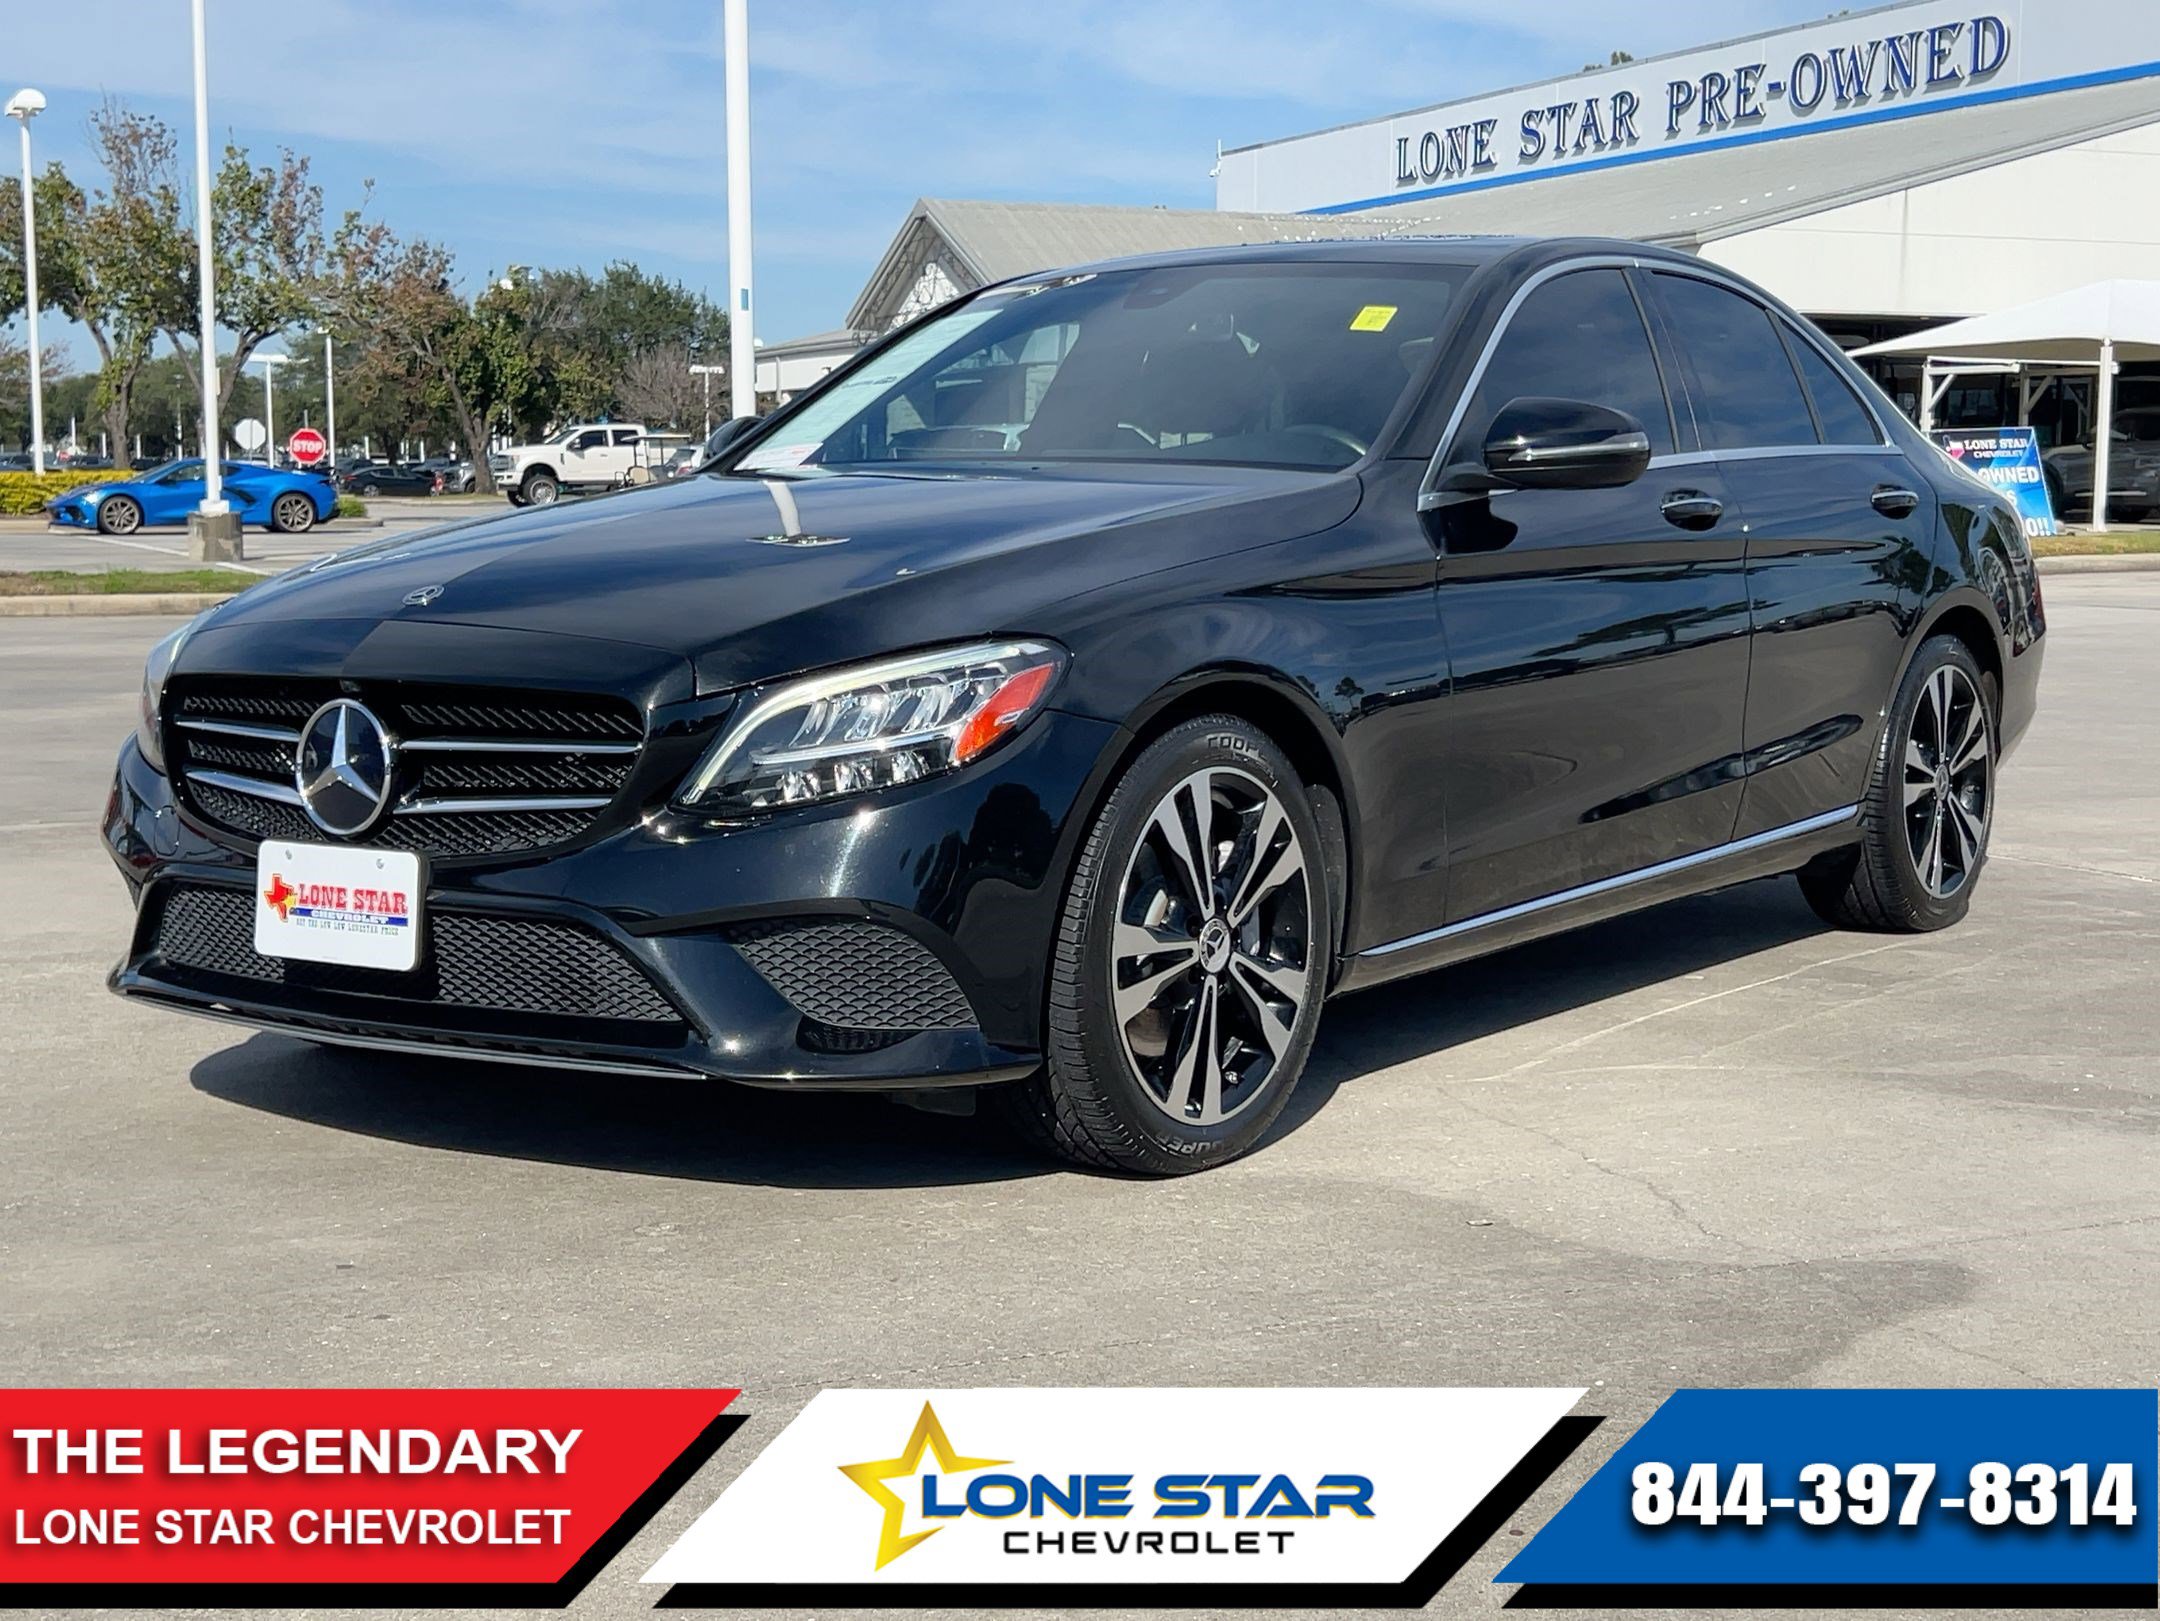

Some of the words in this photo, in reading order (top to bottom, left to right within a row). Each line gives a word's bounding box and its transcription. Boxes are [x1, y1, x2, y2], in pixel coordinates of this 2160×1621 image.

[1396, 118, 1497, 186] LONE
[1518, 92, 1640, 164] STAR
[1665, 15, 2011, 135] PRE-OWNED
[293, 439, 323, 453] STOP
[1964, 439, 1997, 450] LONE
[299, 883, 347, 909] LONE
[353, 888, 408, 914] STAR
[310, 909, 389, 925] CHEVROLET
